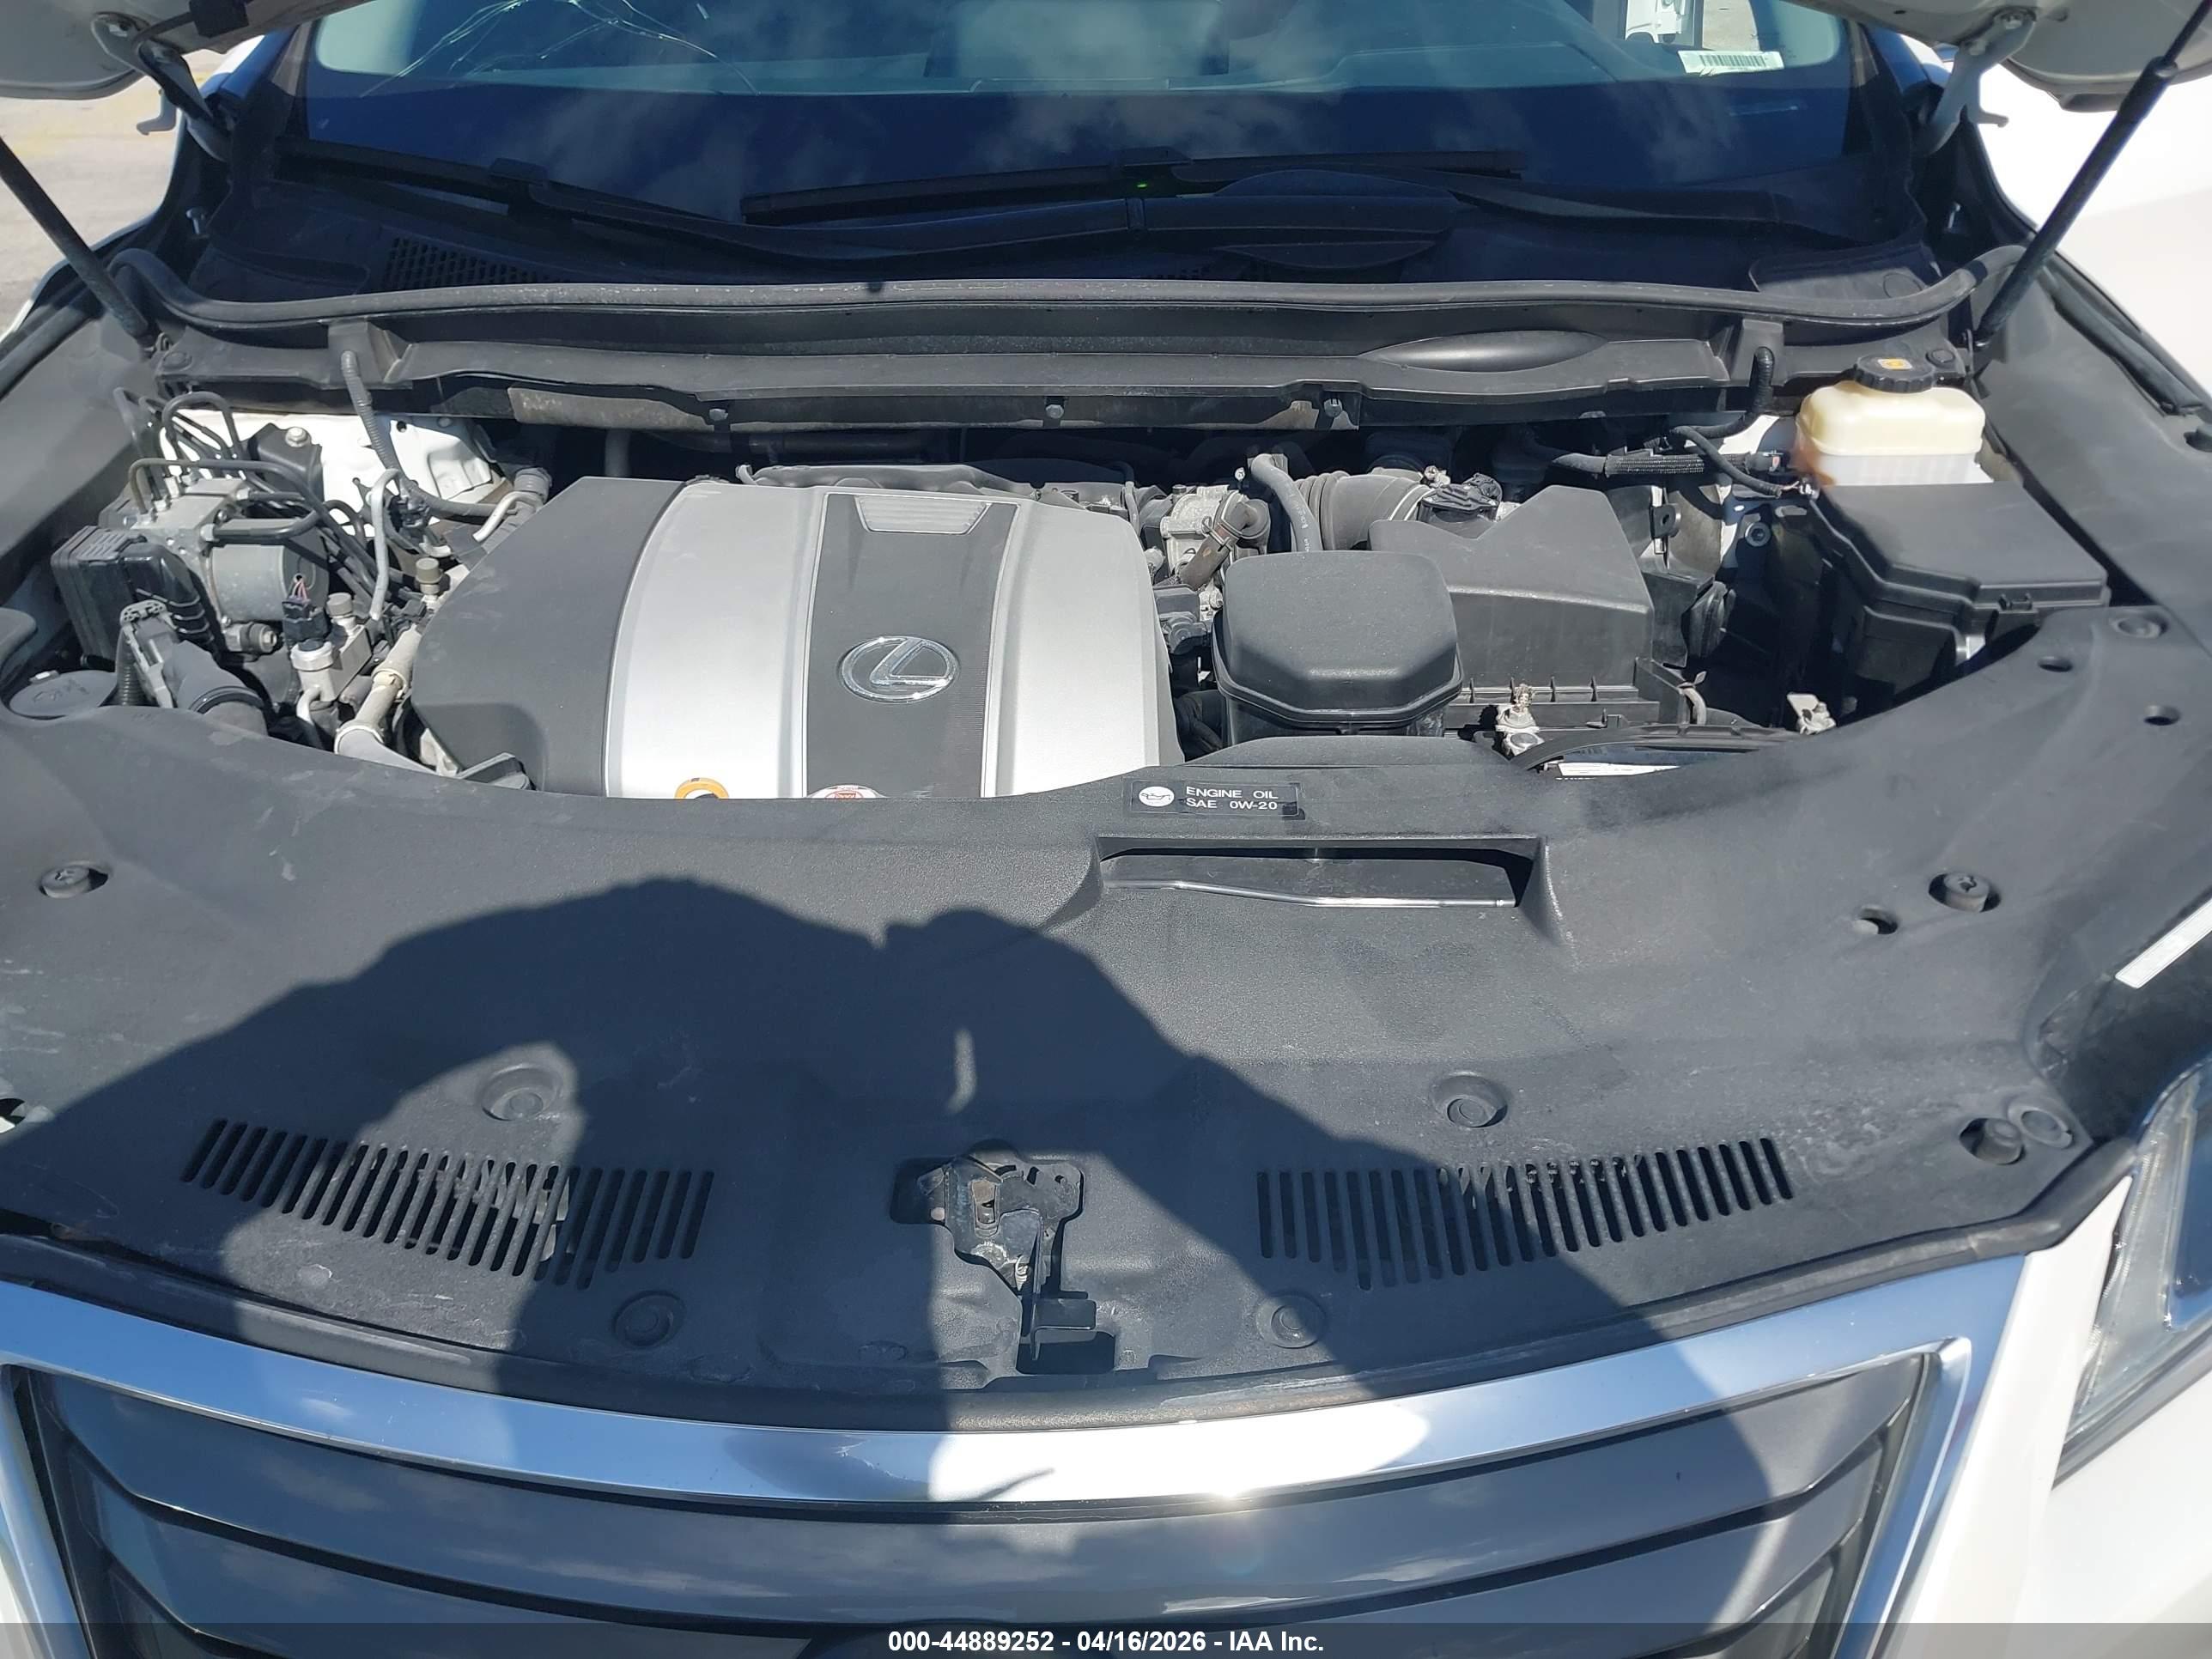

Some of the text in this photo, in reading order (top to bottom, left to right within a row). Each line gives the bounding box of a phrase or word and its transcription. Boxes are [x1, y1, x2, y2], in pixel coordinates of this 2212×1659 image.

[1186, 785, 1279, 799] ENGINE OIL
[1186, 797, 1279, 811] SAE 0W-20
